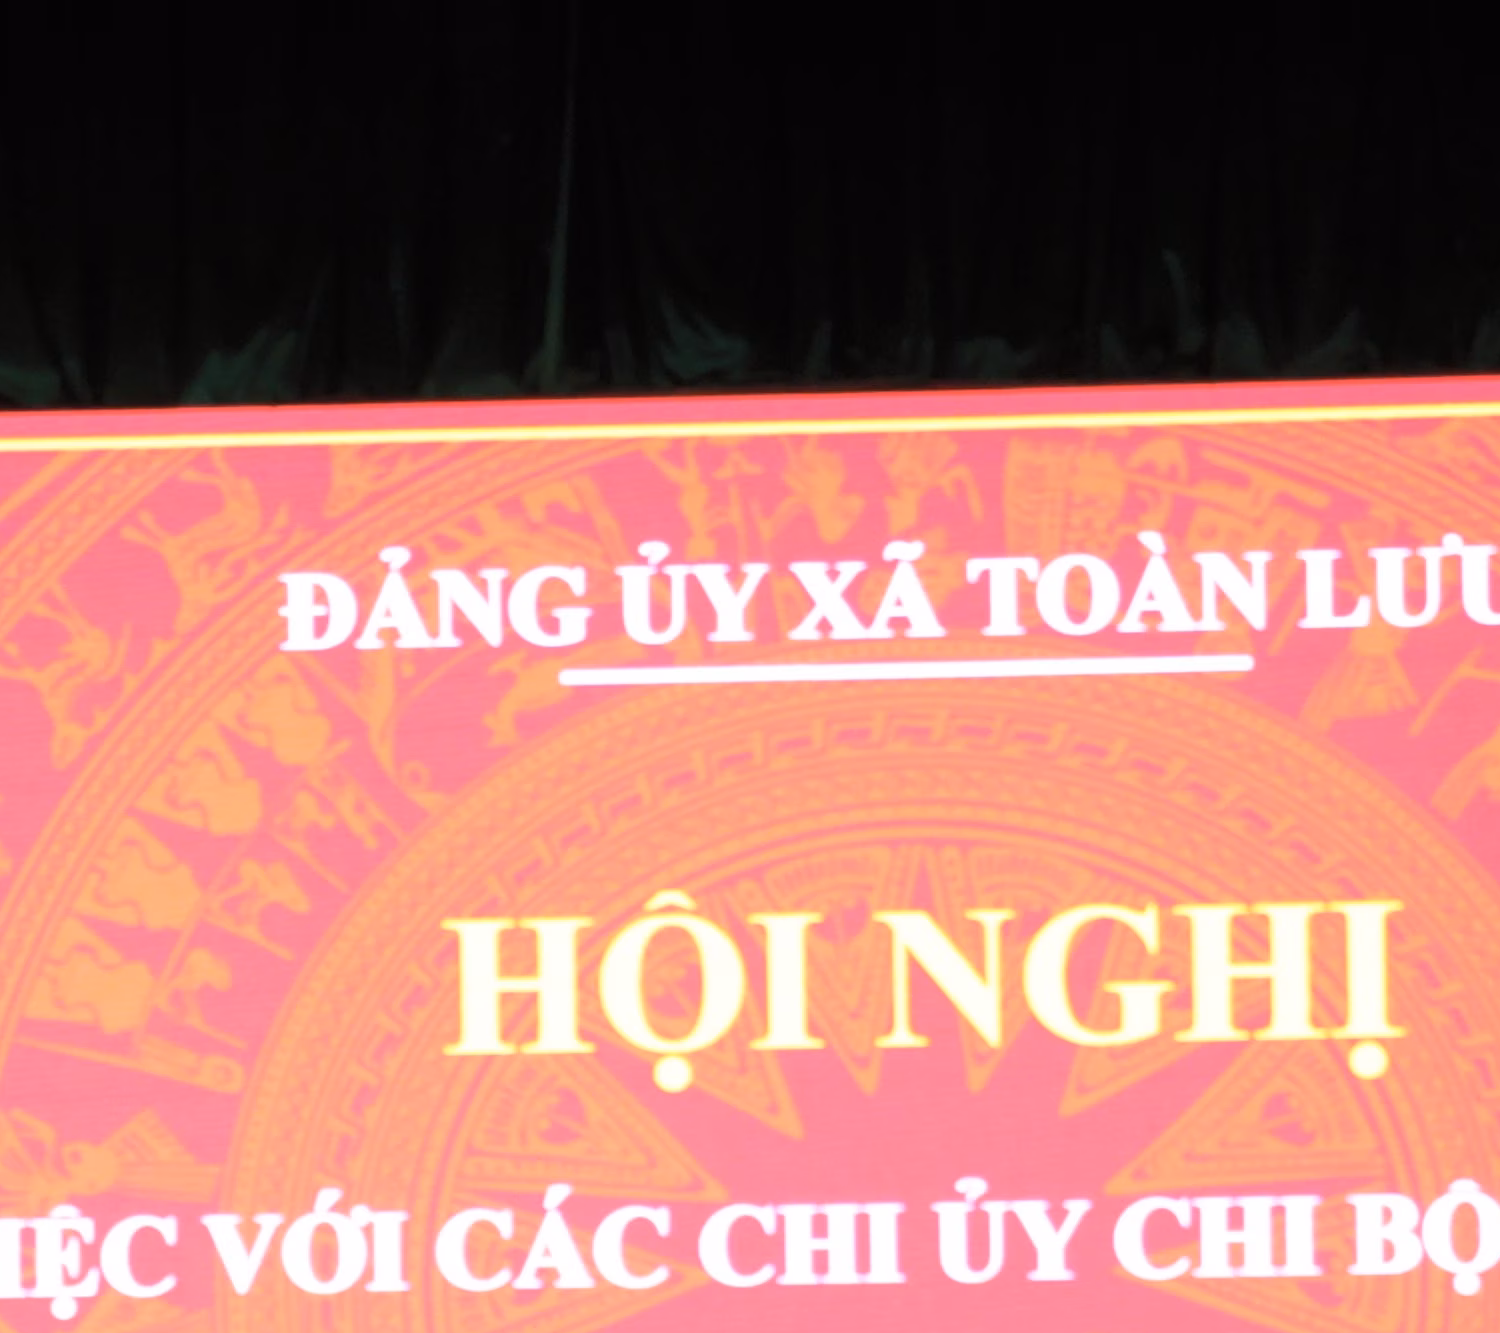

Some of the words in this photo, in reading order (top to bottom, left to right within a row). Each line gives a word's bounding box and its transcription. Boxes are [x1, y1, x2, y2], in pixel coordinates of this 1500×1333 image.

[278, 547, 590, 650] ĐẢNG
[616, 542, 768, 644] ỦY
[789, 541, 945, 640] XÃ
[966, 531, 1270, 636] TOÀN
[442, 890, 822, 1093] HỘI
[874, 900, 1404, 1080] NGHỊ
[202, 1188, 408, 1294] VỚI
[436, 1184, 670, 1292] CÁC
[699, 1203, 904, 1287] CHI
[933, 1178, 1090, 1283] ỦY
[1114, 1196, 1321, 1280] CHI
